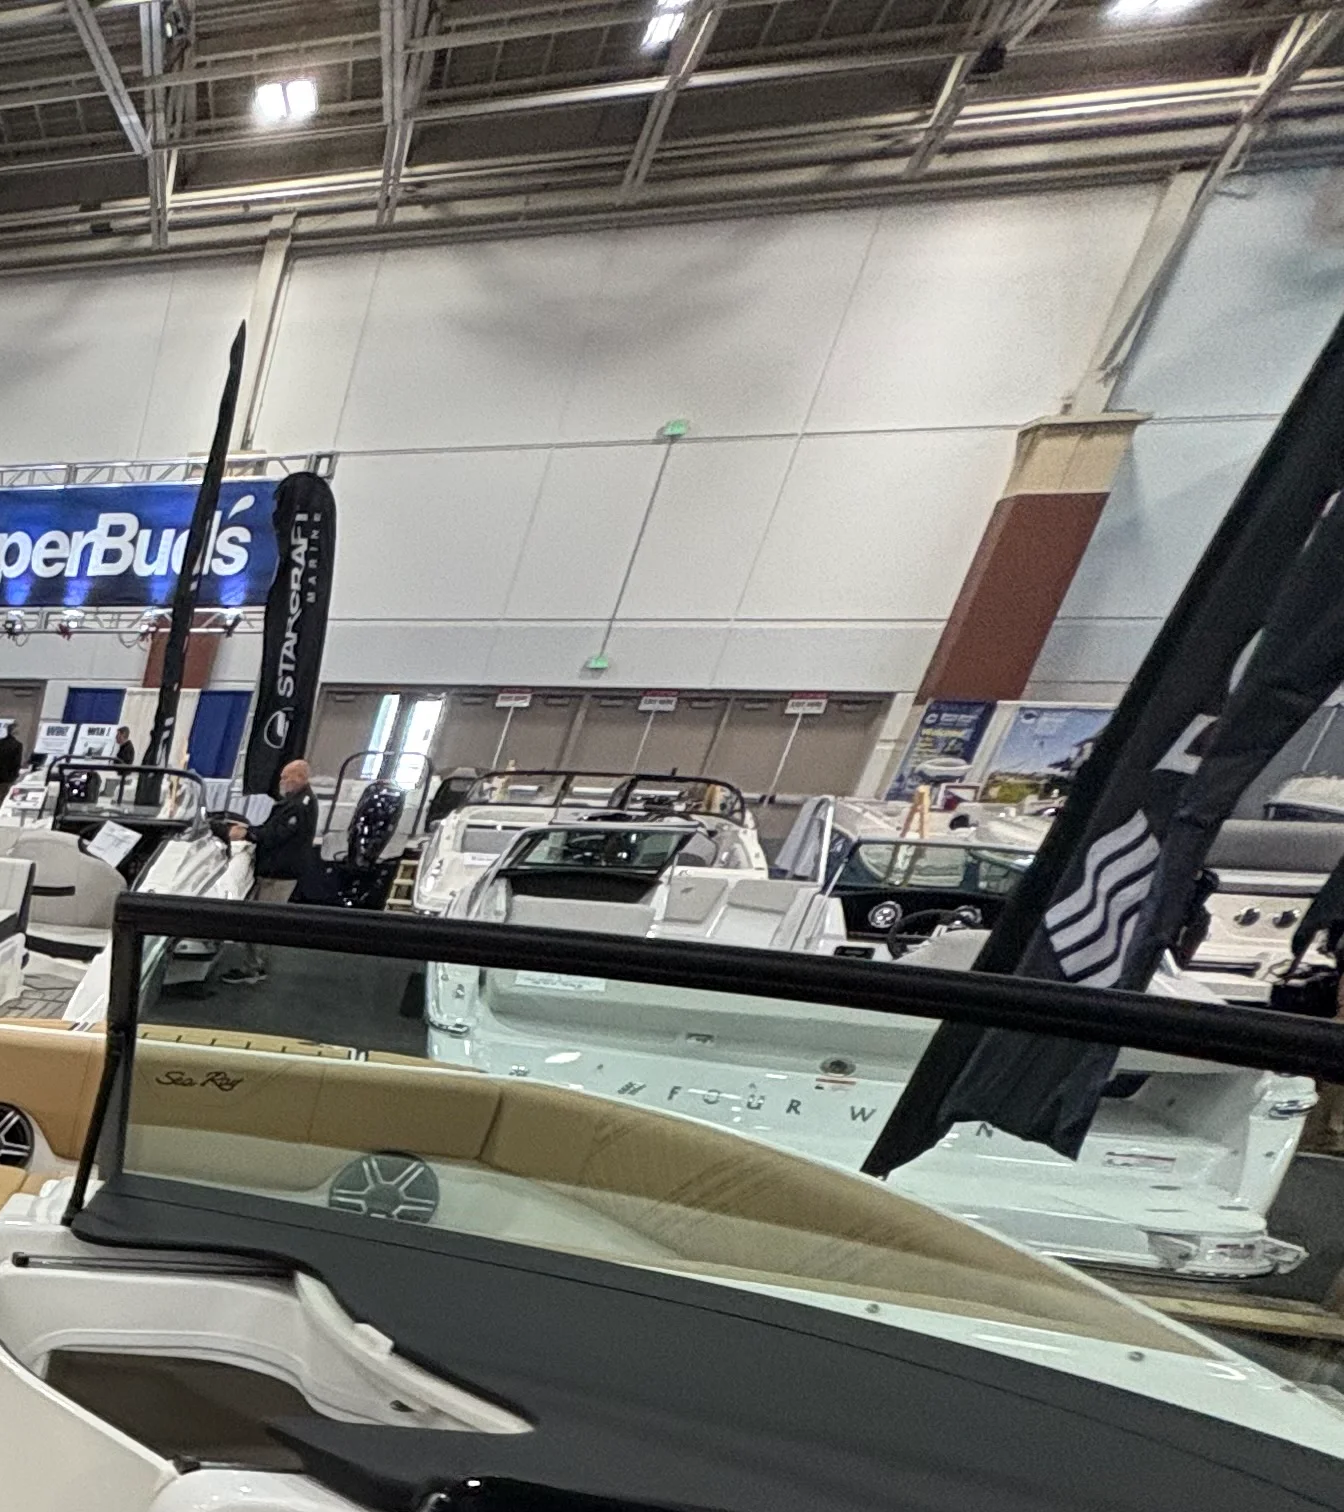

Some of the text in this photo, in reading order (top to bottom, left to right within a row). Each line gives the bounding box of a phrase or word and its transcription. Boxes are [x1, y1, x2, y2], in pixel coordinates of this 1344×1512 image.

[306, 512, 323, 605] MARINE
[155, 1070, 245, 1092] Sea Ray
